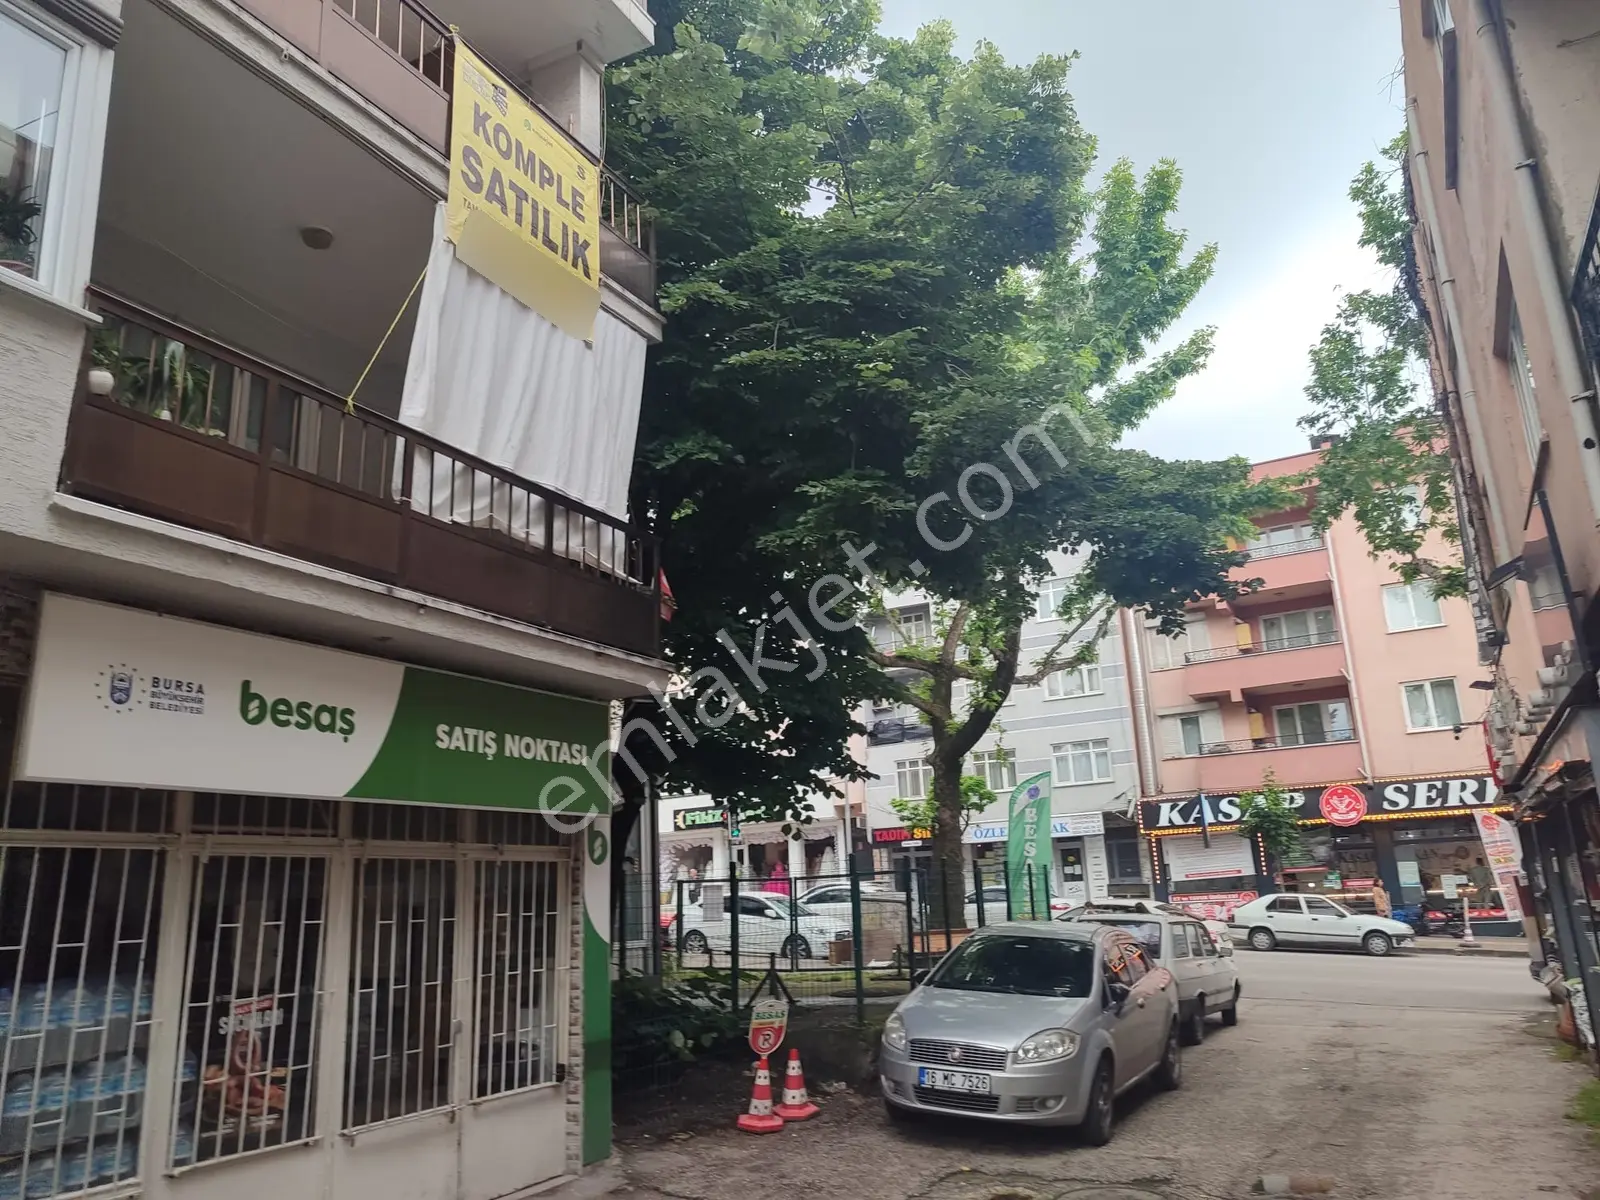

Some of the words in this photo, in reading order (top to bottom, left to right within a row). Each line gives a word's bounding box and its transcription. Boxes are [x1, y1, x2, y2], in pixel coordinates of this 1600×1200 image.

[473, 100, 585, 223] KOMPLE
[461, 145, 592, 281] SATILIK
[151, 676, 205, 695] BURSA
[240, 679, 355, 743] besaş
[435, 723, 498, 761] SATIŞ
[504, 733, 588, 767] NOKTASI
[974, 825, 1007, 839] ÖZLE
[926, 1071, 937, 1084] 16
